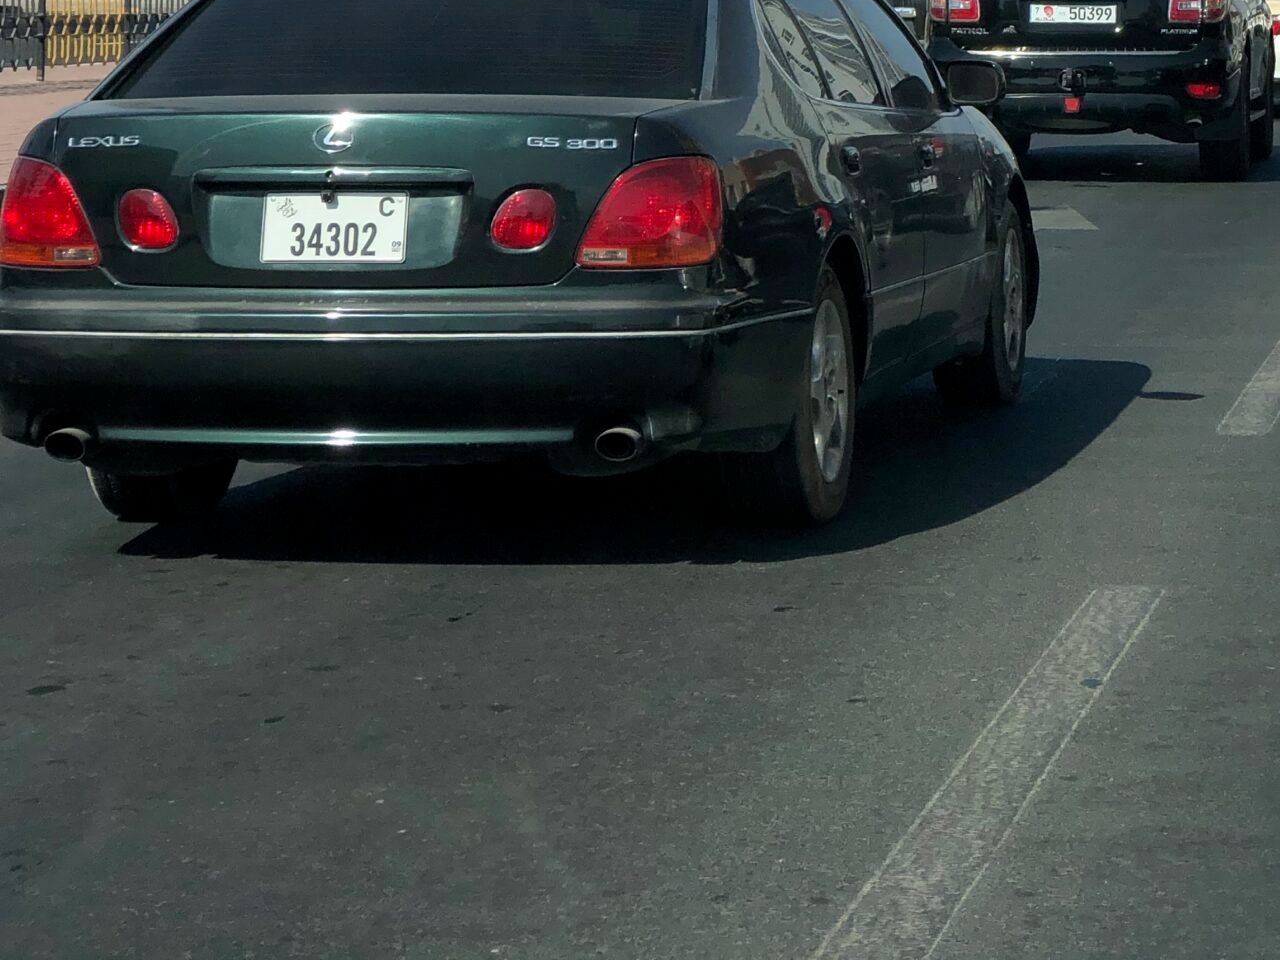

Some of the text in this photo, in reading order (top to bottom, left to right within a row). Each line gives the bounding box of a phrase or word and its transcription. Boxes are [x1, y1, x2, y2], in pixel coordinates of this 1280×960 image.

[1069, 6, 1112, 21] 50399
[950, 27, 990, 35] PATROL
[68, 135, 140, 148] LEXUS
[526, 136, 618, 150] GS 300
[379, 196, 396, 217] C
[290, 222, 378, 257] 34302
